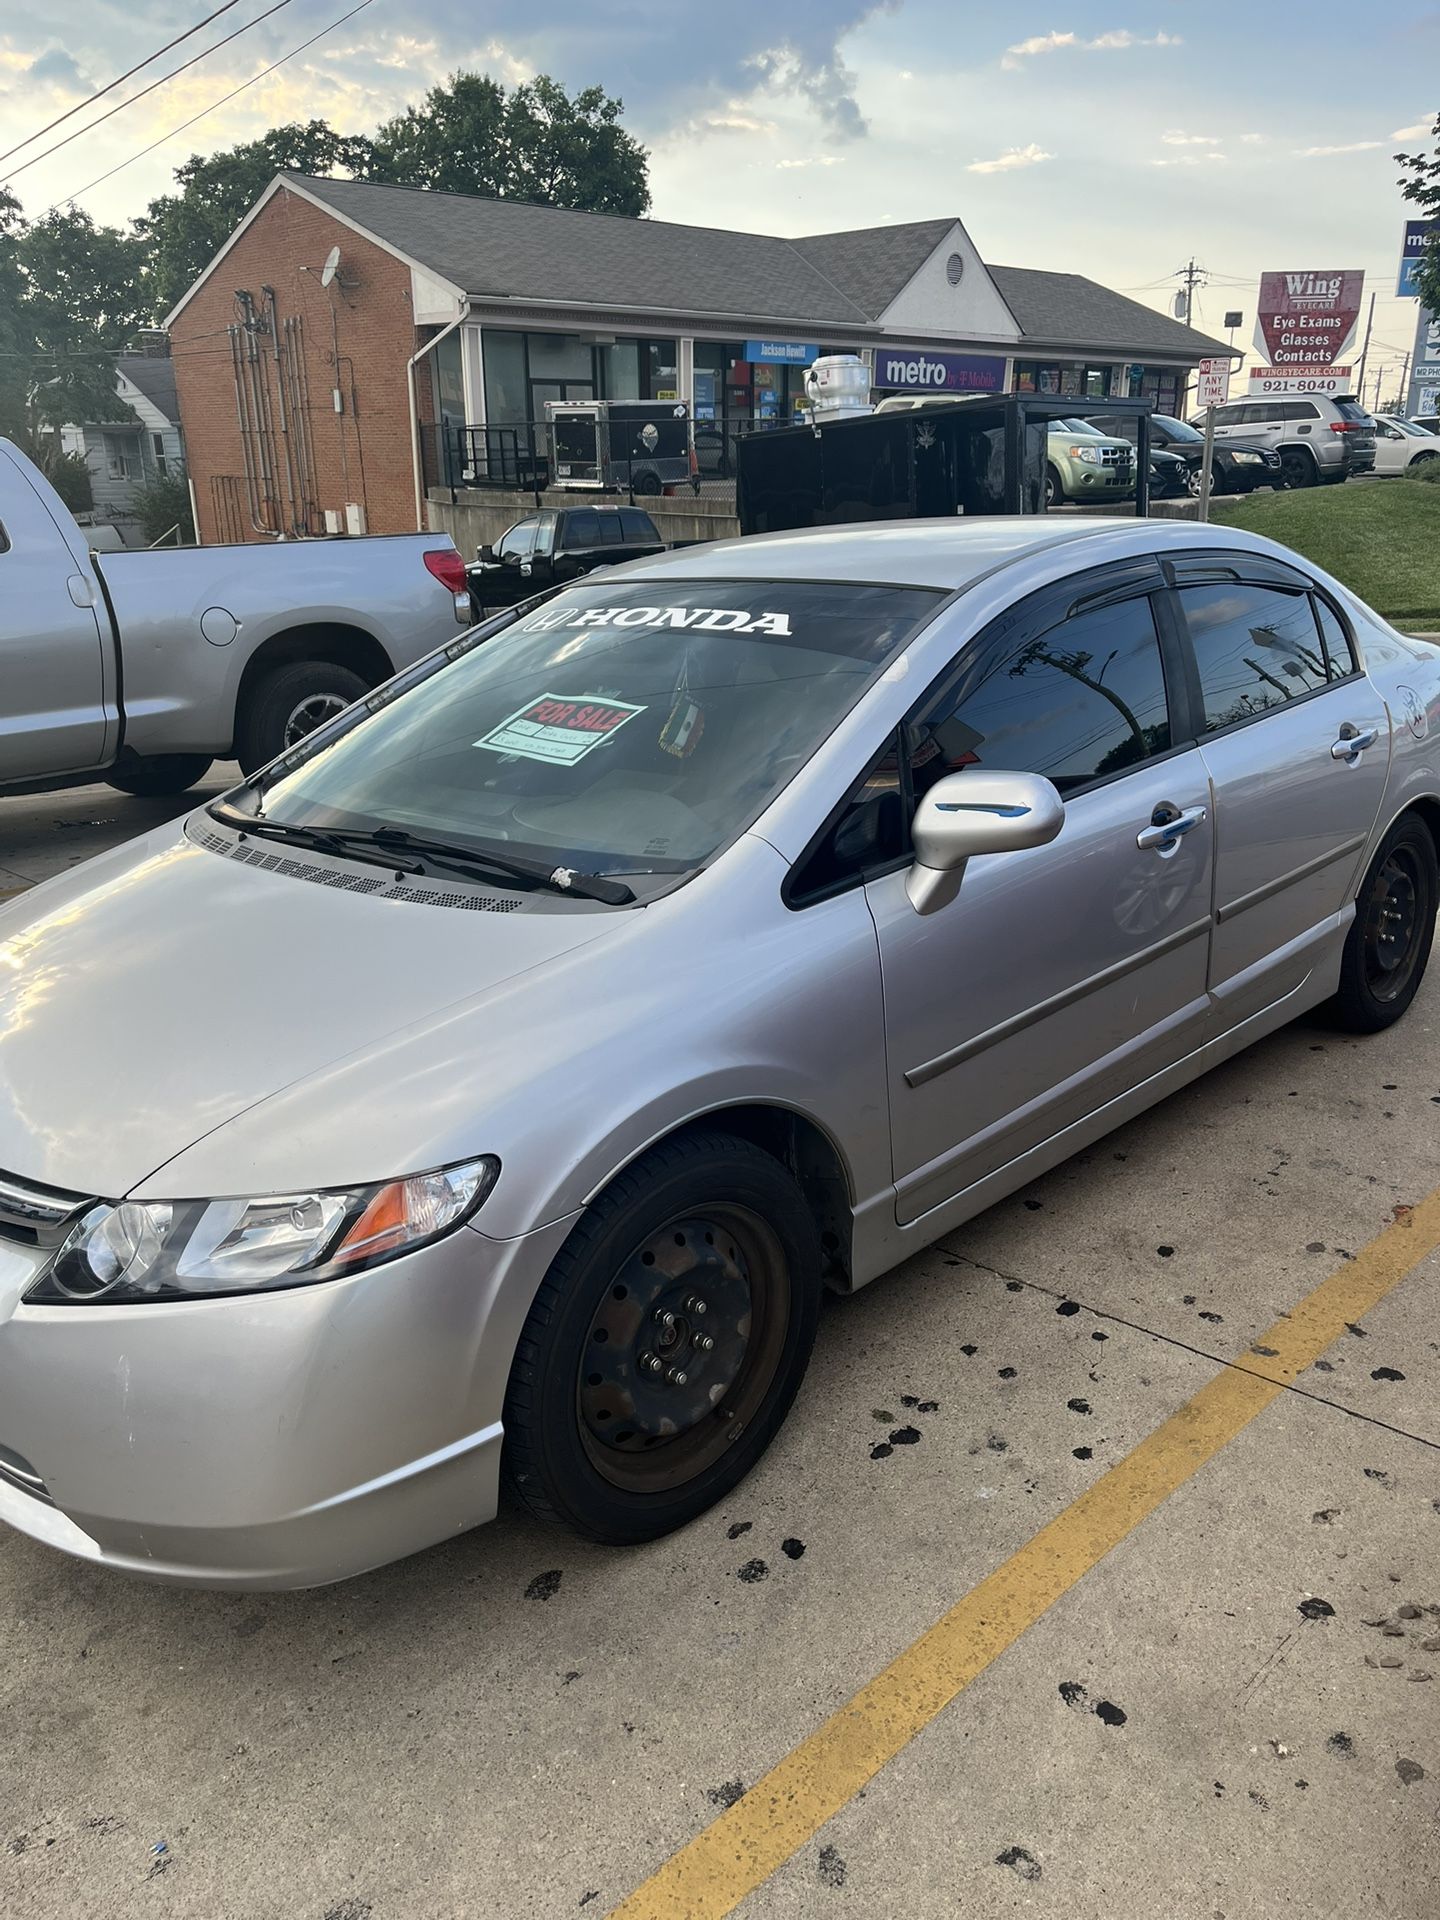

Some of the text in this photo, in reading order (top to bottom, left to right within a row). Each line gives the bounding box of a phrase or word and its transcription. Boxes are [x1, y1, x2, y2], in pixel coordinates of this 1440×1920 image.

[1407, 235, 1440, 246] me
[1285, 274, 1342, 298] Wing
[1273, 315, 1342, 330] Eye Exams
[1281, 333, 1329, 346] Glasses
[760, 343, 806, 358] Jackson Hewitt
[1274, 349, 1332, 362] Contacts
[886, 357, 947, 385] metro
[947, 371, 956, 388] by
[1200, 361, 1210, 373] NO
[1260, 367, 1343, 377] WINGEYECARE.COM
[1205, 376, 1223, 385] ANY
[1262, 380, 1337, 392] 921-8040
[1204, 387, 1223, 396] TIME
[566, 607, 793, 636] HONDA
[524, 700, 633, 731] FOR SALE
